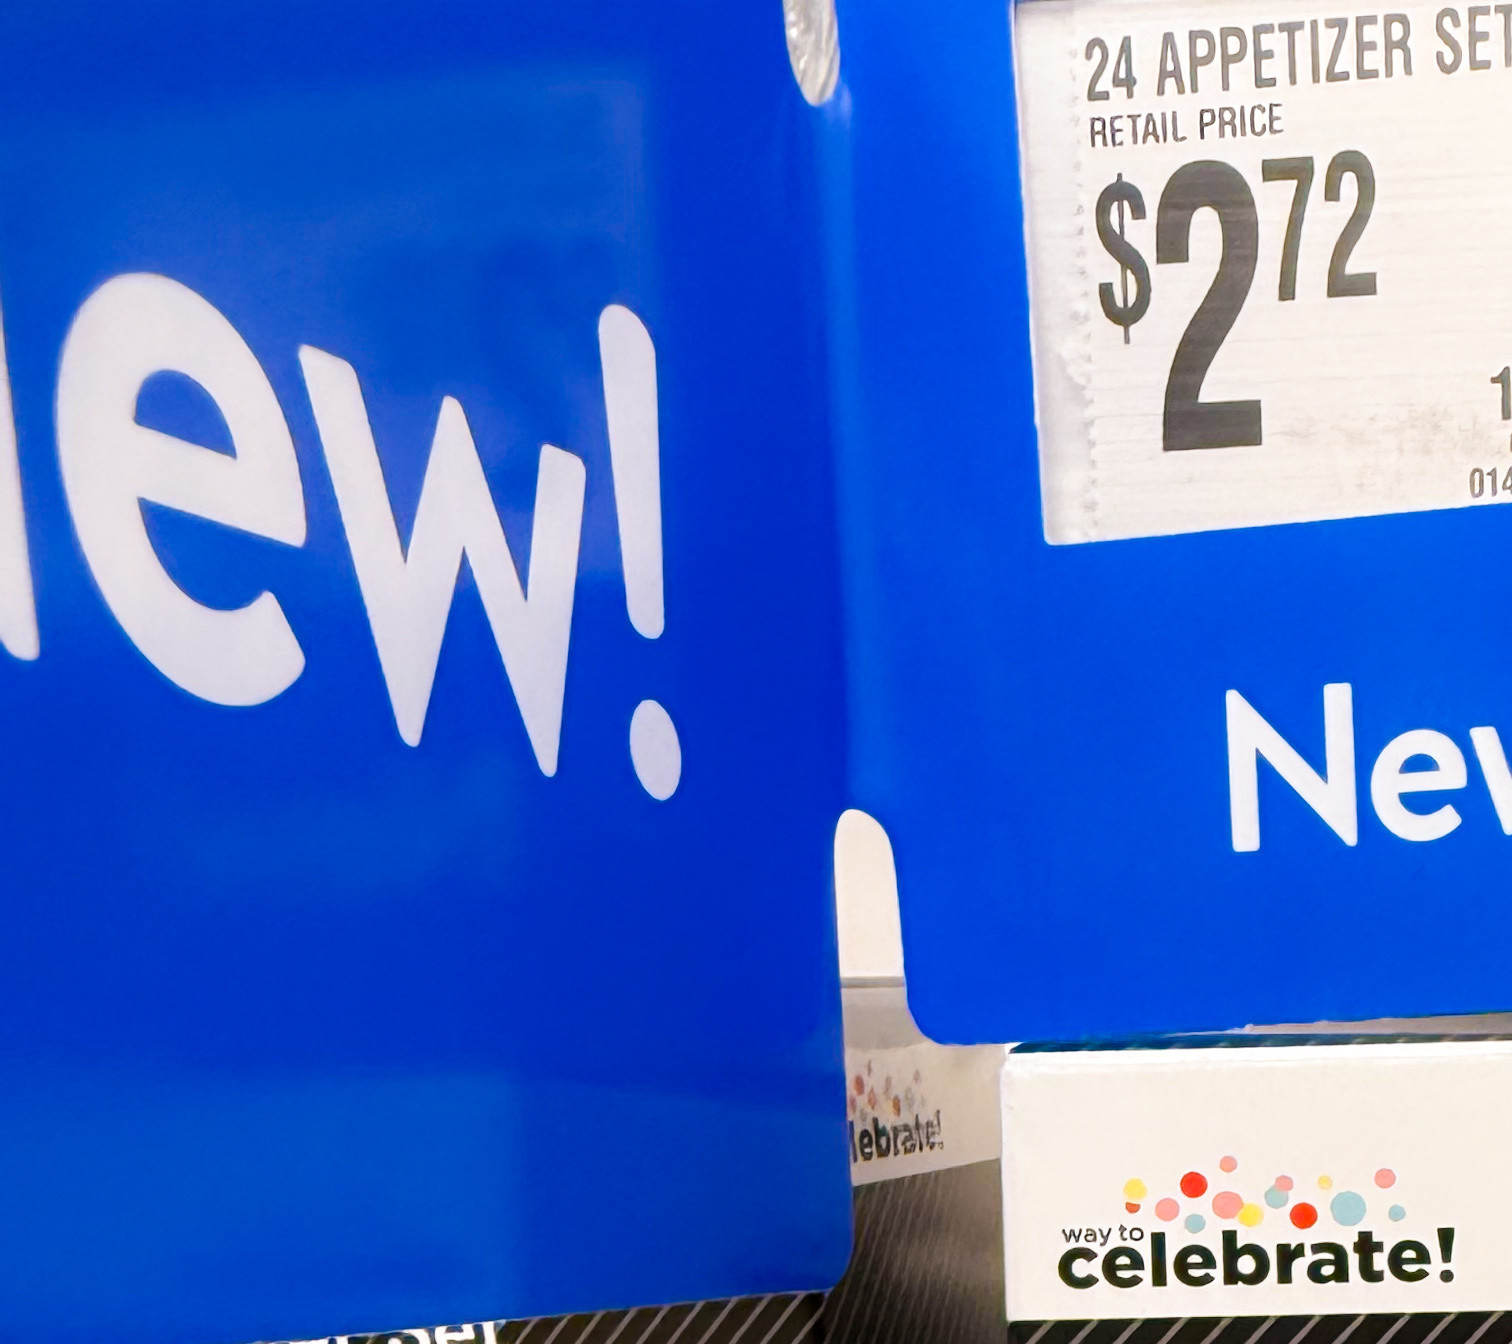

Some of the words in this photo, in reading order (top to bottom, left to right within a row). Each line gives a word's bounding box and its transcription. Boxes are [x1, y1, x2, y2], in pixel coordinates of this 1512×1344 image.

[1084, 35, 1137, 102] 24
[1156, 13, 1413, 97] APPETIZER
[1090, 110, 1187, 148] RETAIL
[1199, 102, 1284, 140] PRICE
[0, 272, 682, 801] ew!
[1057, 1227, 1456, 1290] celebrate!
[1062, 1227, 1112, 1246] way
[1119, 1224, 1145, 1243] to
